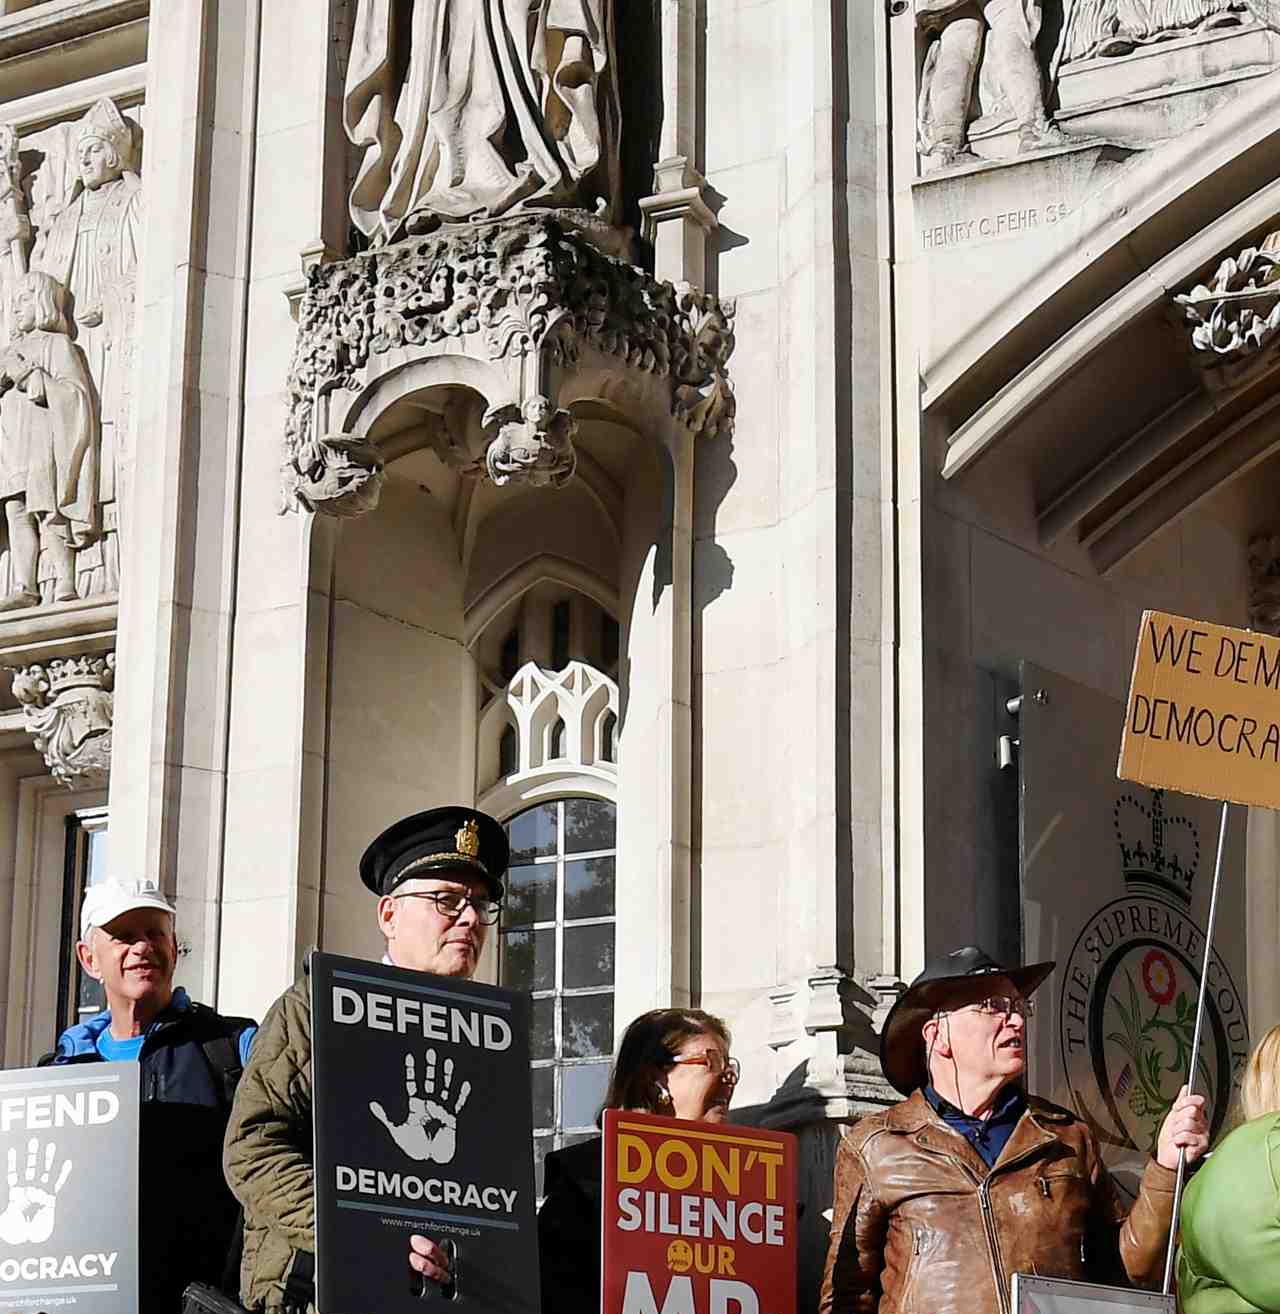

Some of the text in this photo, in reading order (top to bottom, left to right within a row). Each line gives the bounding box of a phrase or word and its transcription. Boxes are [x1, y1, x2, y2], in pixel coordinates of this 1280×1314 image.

[1149, 620, 1208, 674] WE
[1067, 966, 1091, 1053] THE
[1084, 904, 1201, 963] SUPREME
[332, 986, 512, 1052] DEFEND
[336, 1165, 518, 1213] DEMOCRACY
[617, 1133, 784, 1200] DON'T
[617, 1187, 784, 1246] SILENCE
